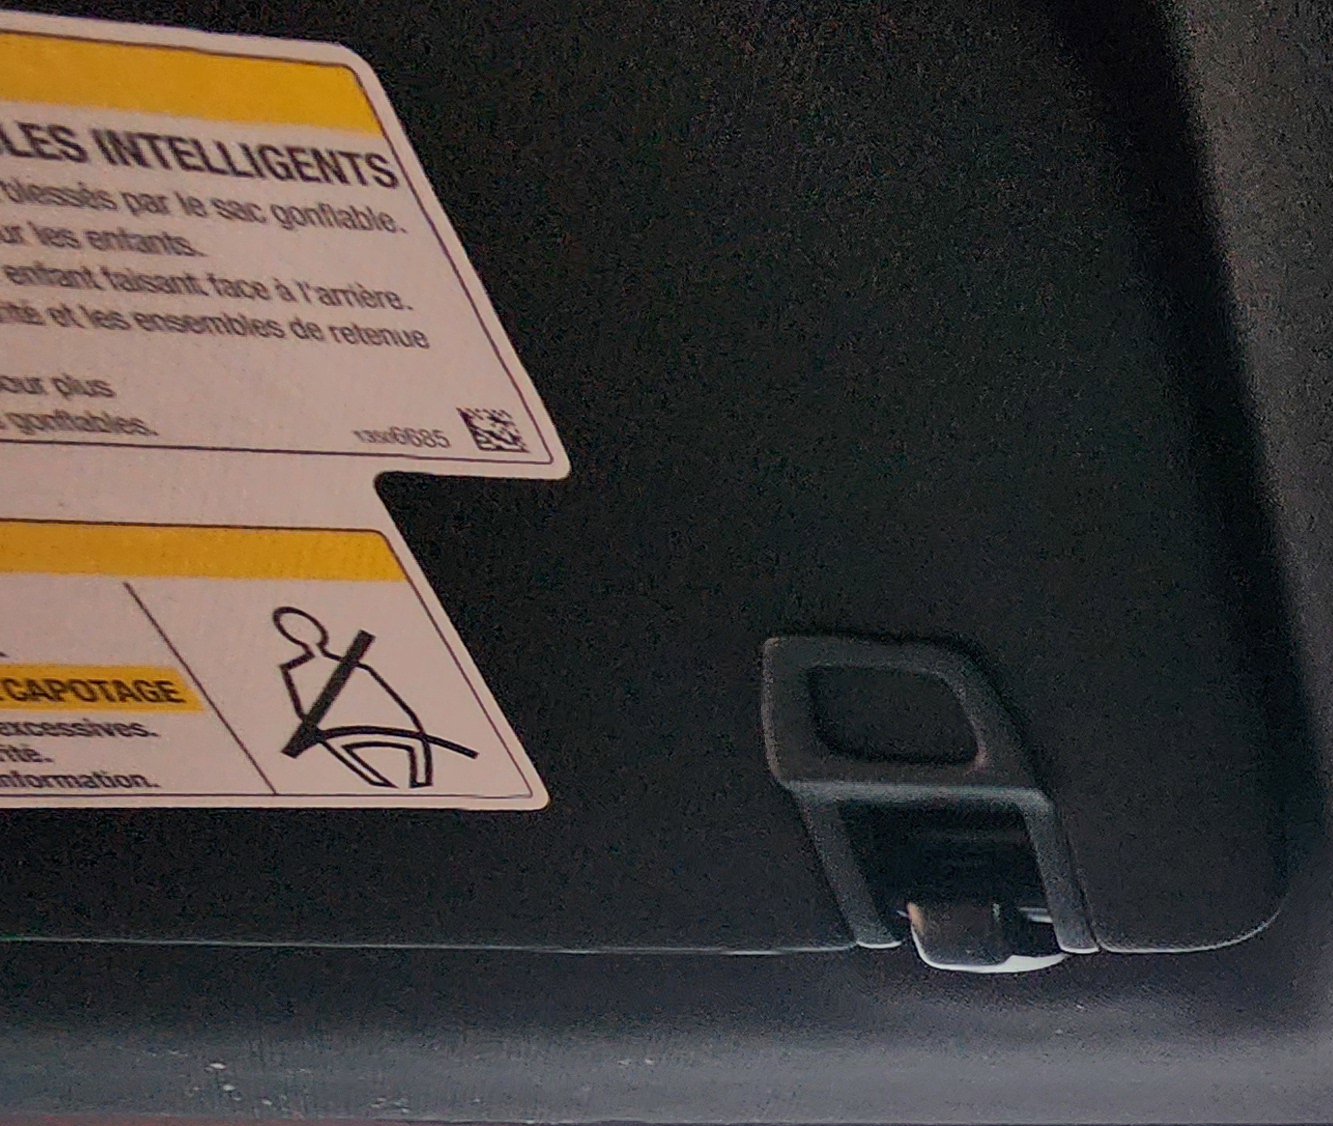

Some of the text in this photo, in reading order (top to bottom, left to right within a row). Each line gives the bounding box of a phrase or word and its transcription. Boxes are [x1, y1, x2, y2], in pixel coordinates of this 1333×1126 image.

[90, 128, 399, 189] INTELLIGENTS
[120, 190, 171, 217] par
[173, 190, 208, 218] le
[209, 197, 266, 224] sac
[270, 201, 408, 234] gonflable.
[27, 221, 81, 249] les
[206, 272, 271, 301] face
[273, 278, 297, 302] à
[78, 304, 131, 331] les
[131, 309, 286, 339] ensembles
[288, 315, 325, 341] de
[328, 322, 429, 349] retenue
[50, 373, 116, 400] plus
[2, 678, 187, 703] CAPOTAGE
